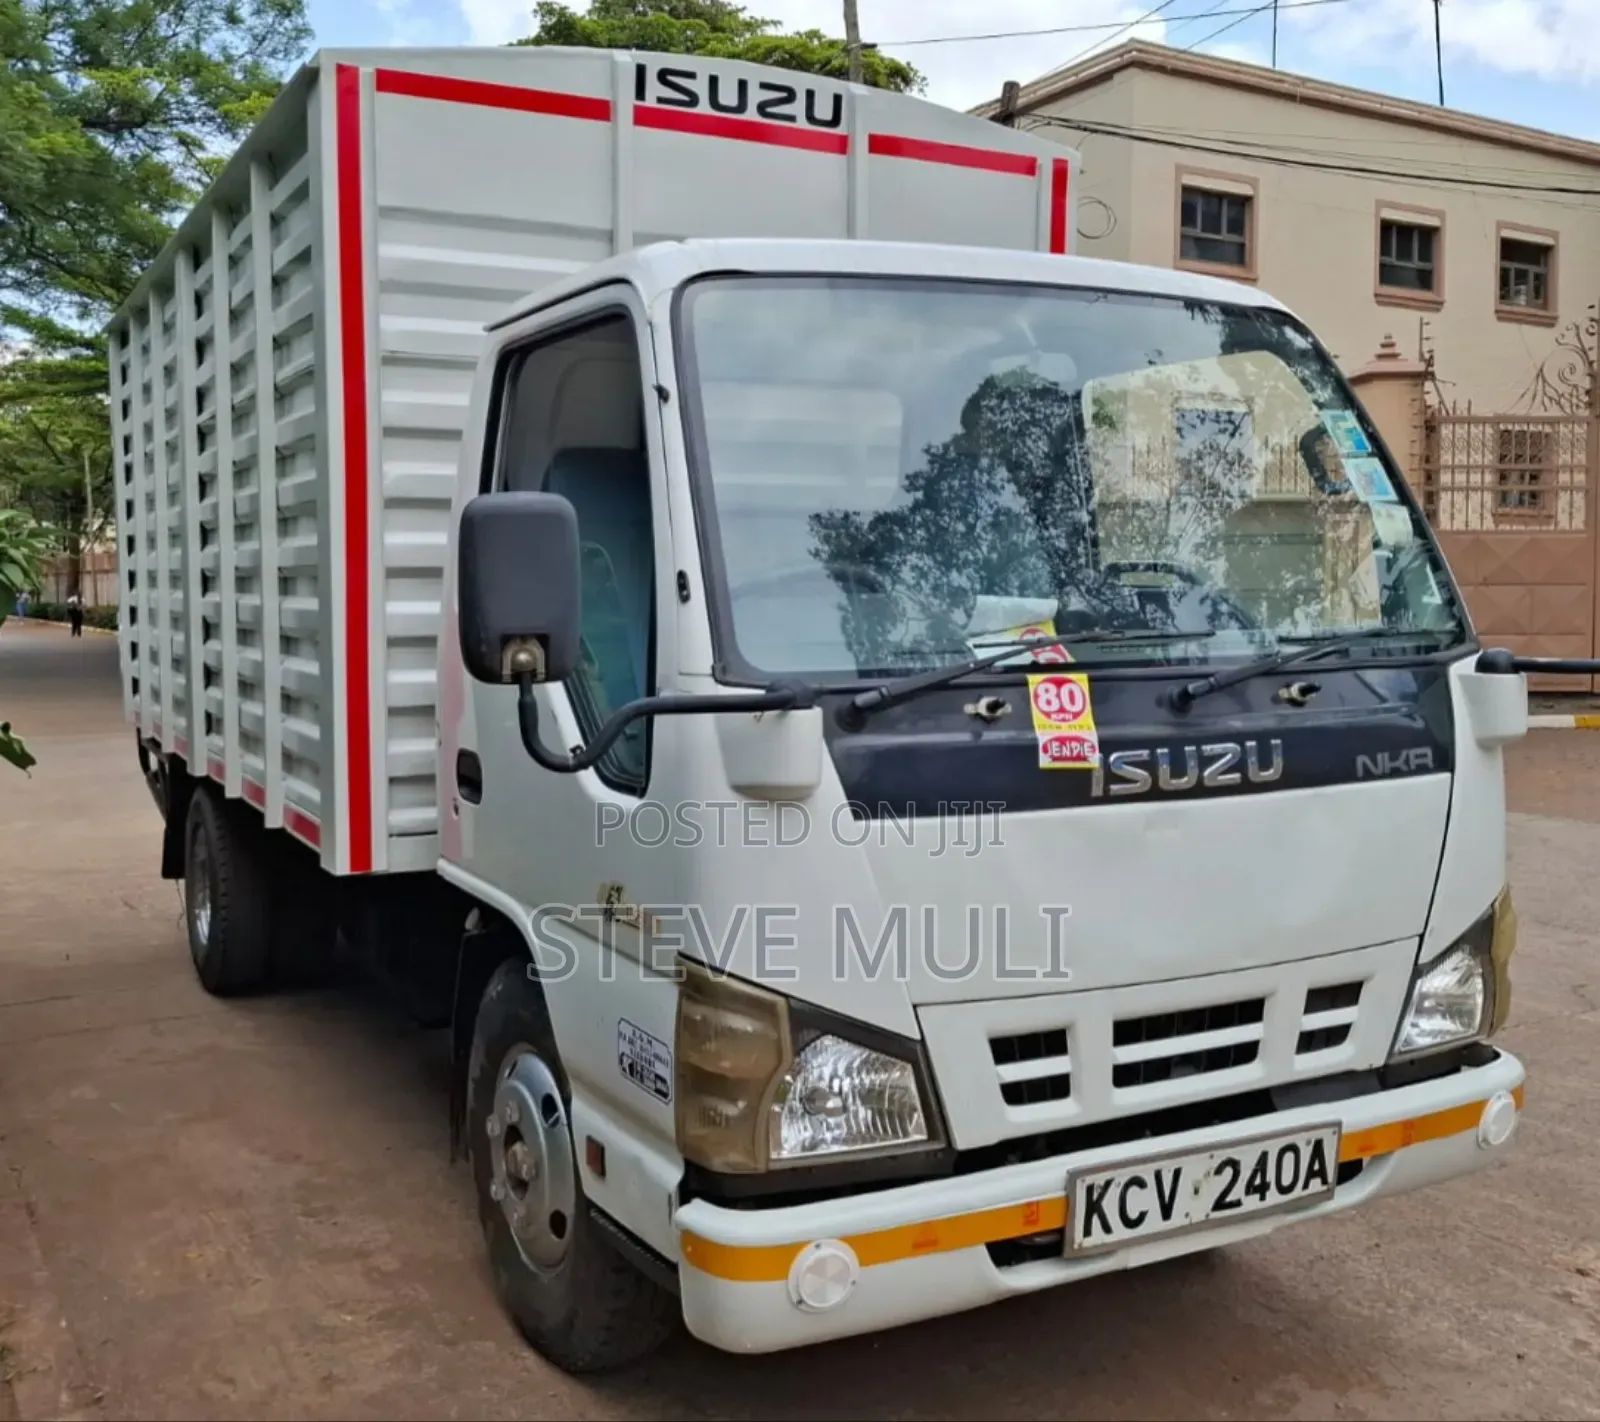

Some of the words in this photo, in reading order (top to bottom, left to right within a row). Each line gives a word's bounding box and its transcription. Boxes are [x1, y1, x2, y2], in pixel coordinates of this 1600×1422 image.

[635, 63, 842, 128] ISUZU
[1037, 682, 1084, 713] 80
[1090, 739, 1283, 797] ISUZU
[1356, 746, 1434, 778] NKR
[1083, 1166, 1182, 1239] KCV
[1211, 1138, 1329, 1212] 240A
